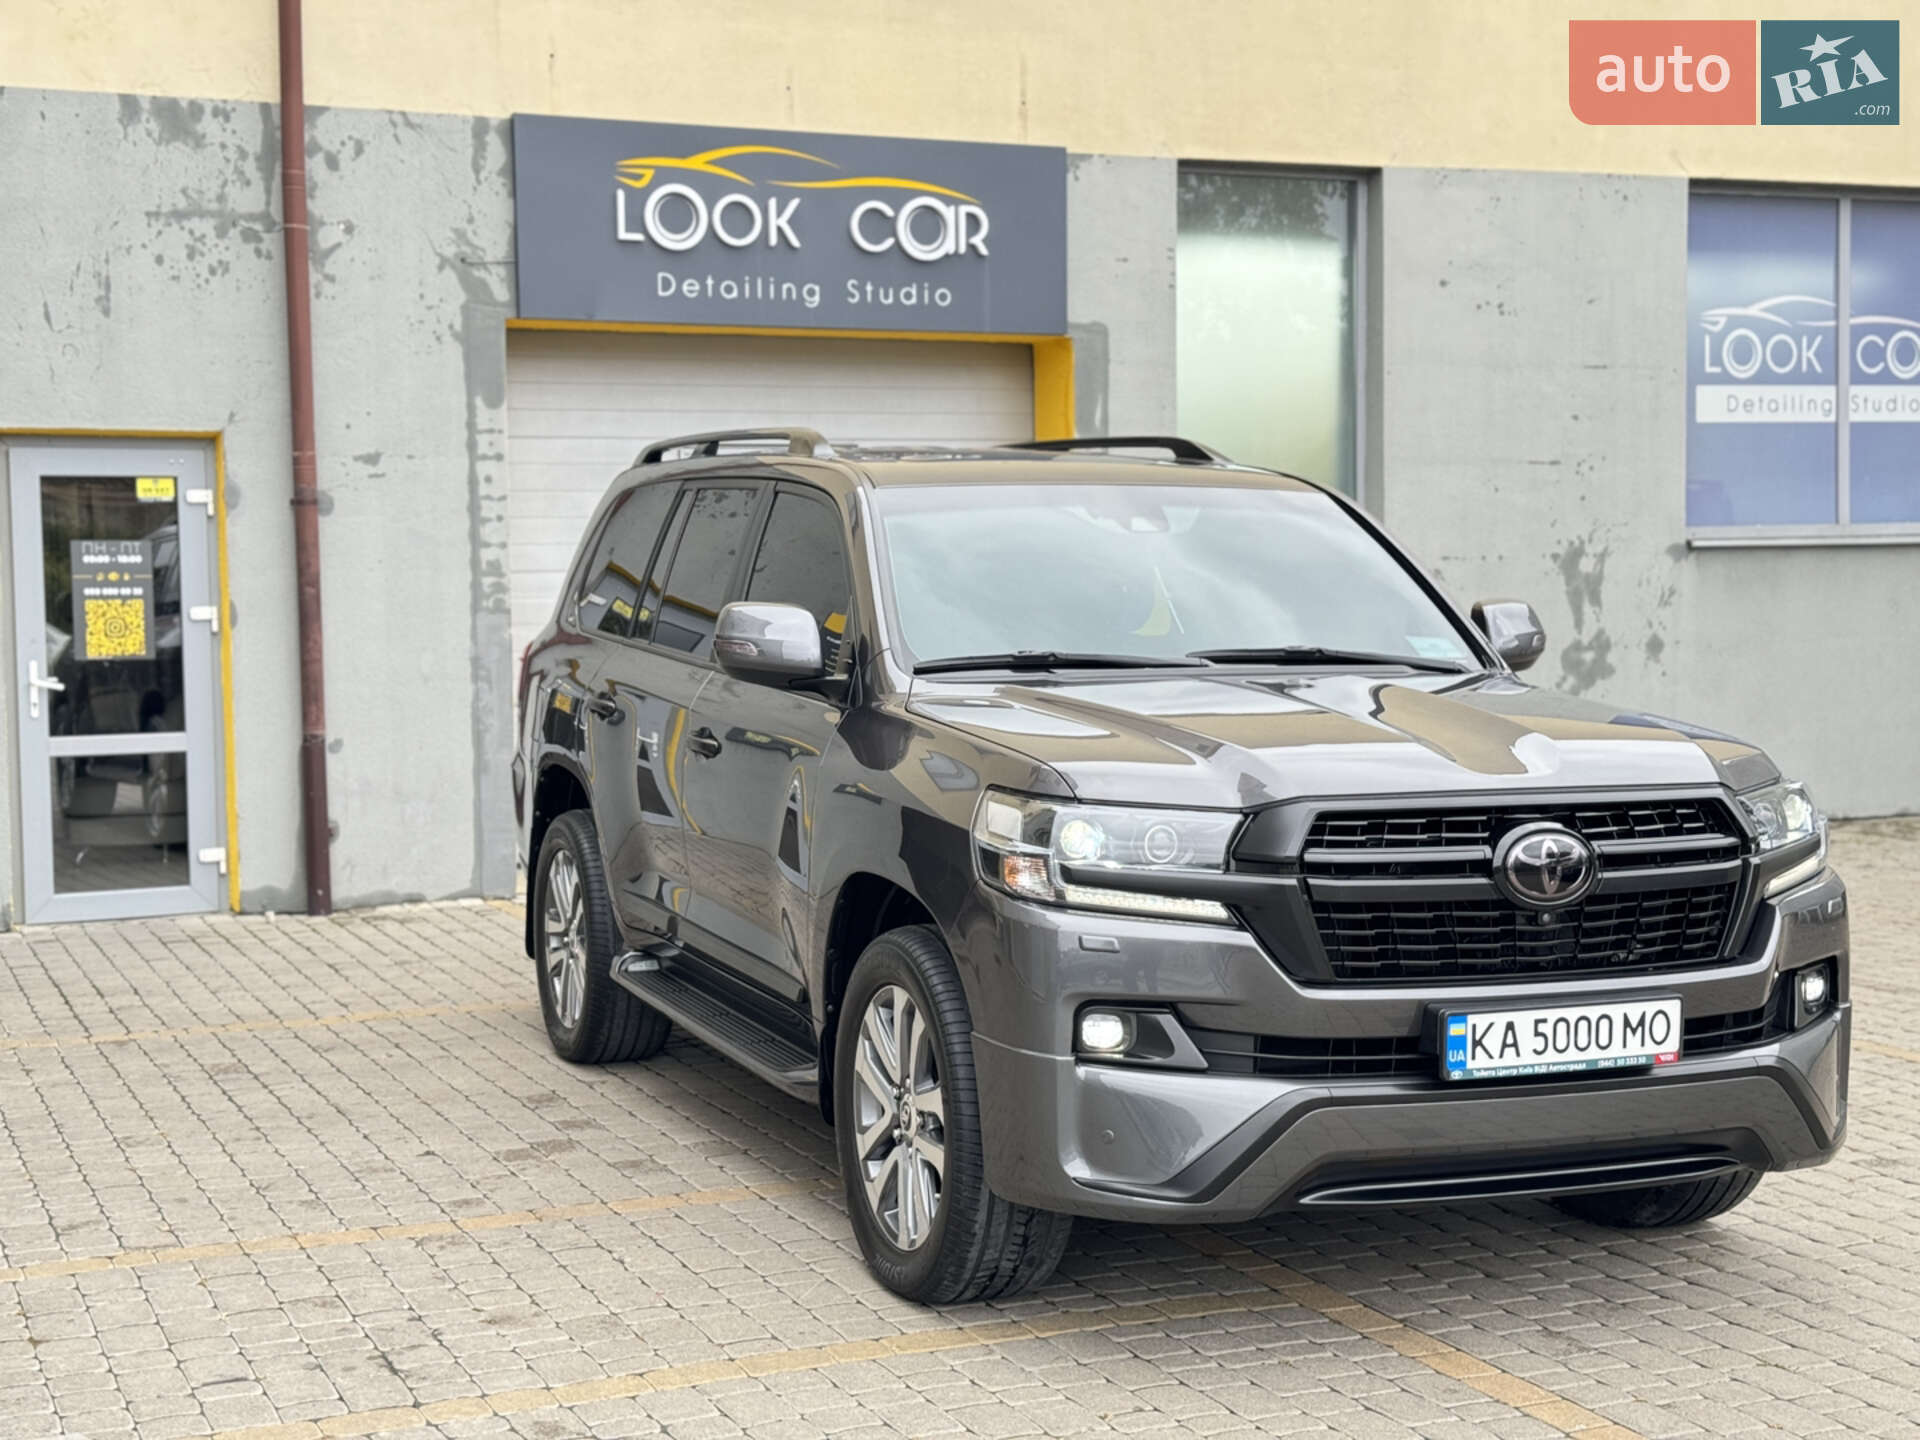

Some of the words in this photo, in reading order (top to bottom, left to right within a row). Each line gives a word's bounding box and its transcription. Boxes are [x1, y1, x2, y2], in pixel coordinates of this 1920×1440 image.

[615, 183, 801, 252] LOOK
[656, 271, 821, 308] Detailing
[847, 279, 952, 306] Studio
[1704, 328, 1823, 379] LOOK
[1726, 394, 1834, 418] Detailing
[1449, 1049, 1466, 1063] UA
[1471, 1020, 1521, 1062] KA
[1532, 1013, 1614, 1057] 5000
[1622, 1008, 1671, 1049] MO
